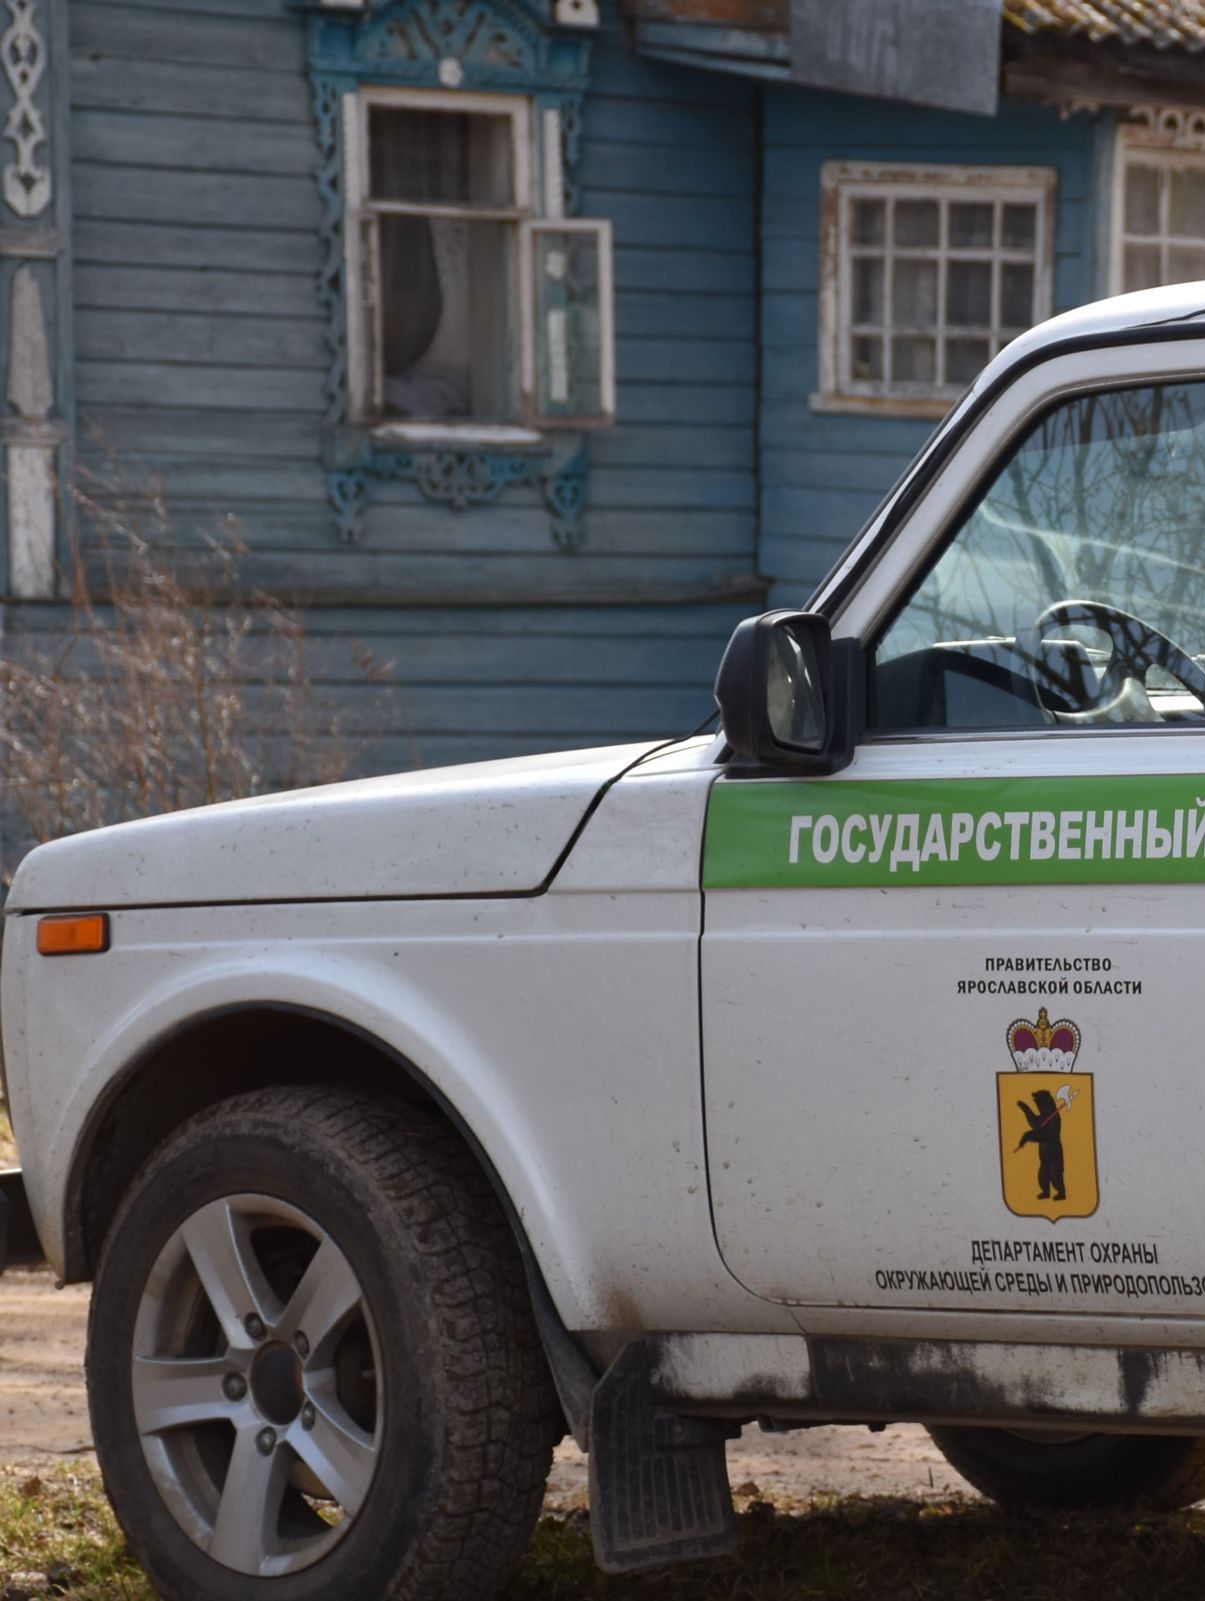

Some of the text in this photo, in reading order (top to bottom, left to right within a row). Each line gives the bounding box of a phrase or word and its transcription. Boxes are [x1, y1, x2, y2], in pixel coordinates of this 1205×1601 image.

[985, 957, 1112, 972] ПРАВИТЕЛЬСТВО
[957, 977, 1142, 995] ЯРОСЛАВСКОЙ ОБЛАСТИ
[971, 1240, 1159, 1265] ДЕПАРТАМЕНТ ОХРАНЫ
[875, 1266, 992, 1295] ОКРУЖАЮЩЕЙ
[995, 1272, 1053, 1296] СРЕДЫ
[1055, 1273, 1068, 1294] И
